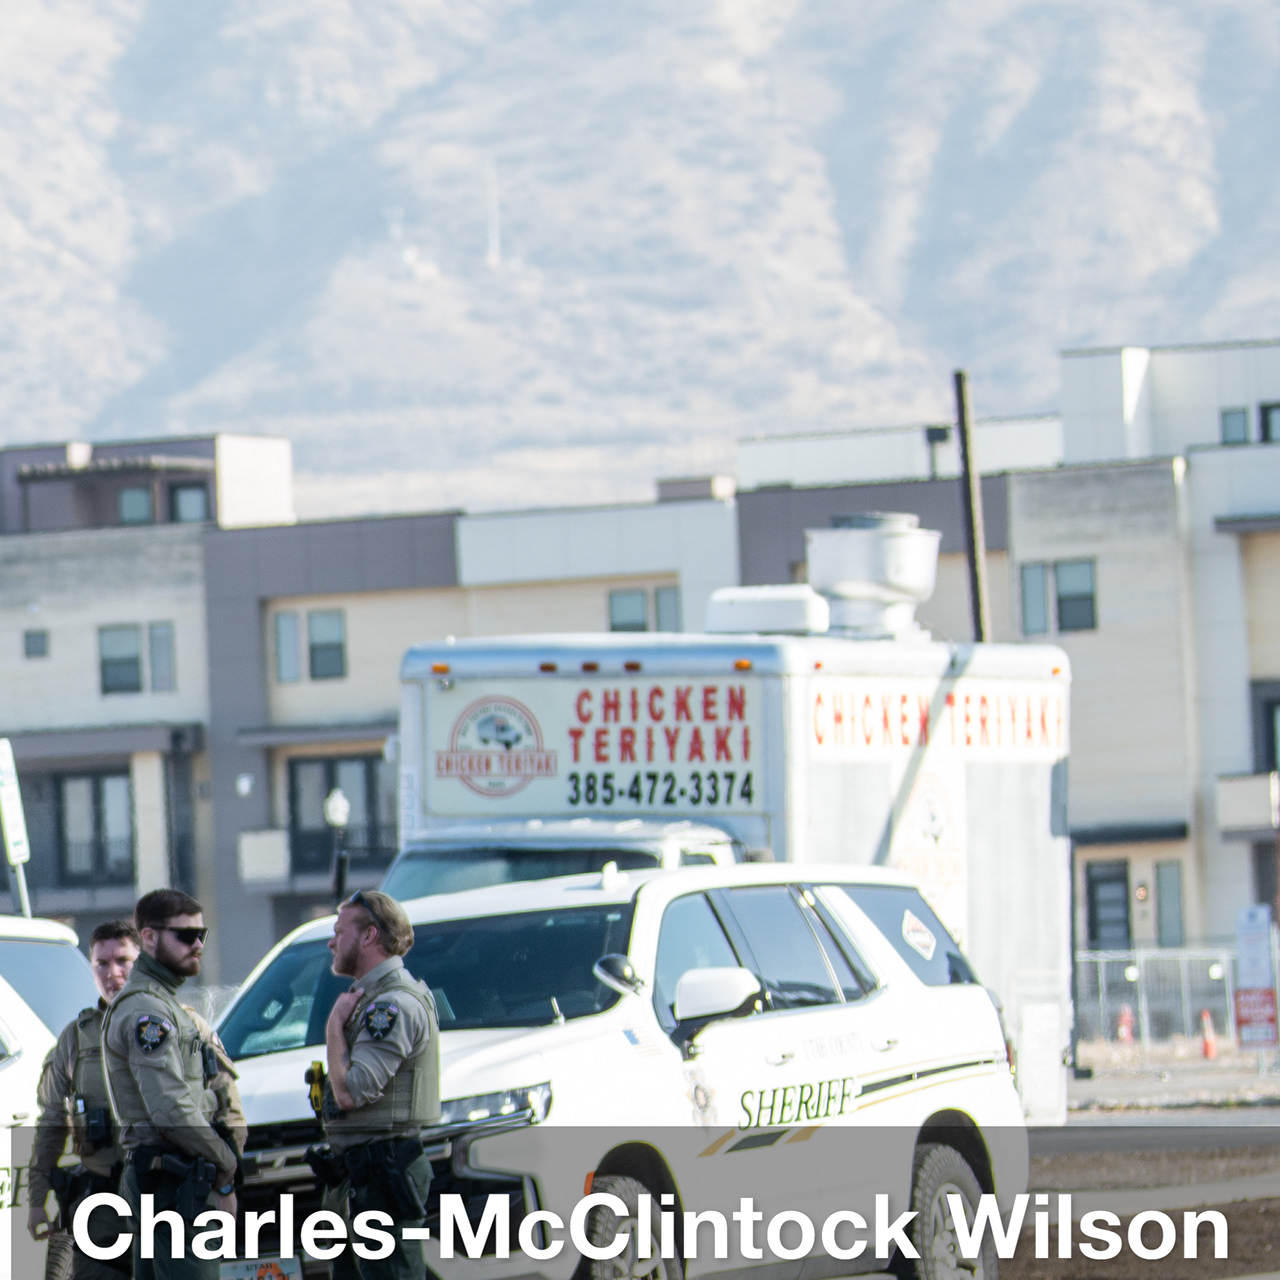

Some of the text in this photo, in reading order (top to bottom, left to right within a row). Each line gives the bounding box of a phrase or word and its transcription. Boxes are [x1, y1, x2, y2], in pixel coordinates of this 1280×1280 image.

[575, 686, 746, 724] CHICKEN
[814, 692, 1062, 747] CHICKEN TERIYAKI
[568, 726, 750, 763] TERIYAKI
[436, 754, 557, 773] CHICKEN TERIYAKI
[568, 771, 754, 806] 385-472-3374
[738, 1077, 854, 1131] SHERIFF
[246, 1263, 272, 1271] UTAH
